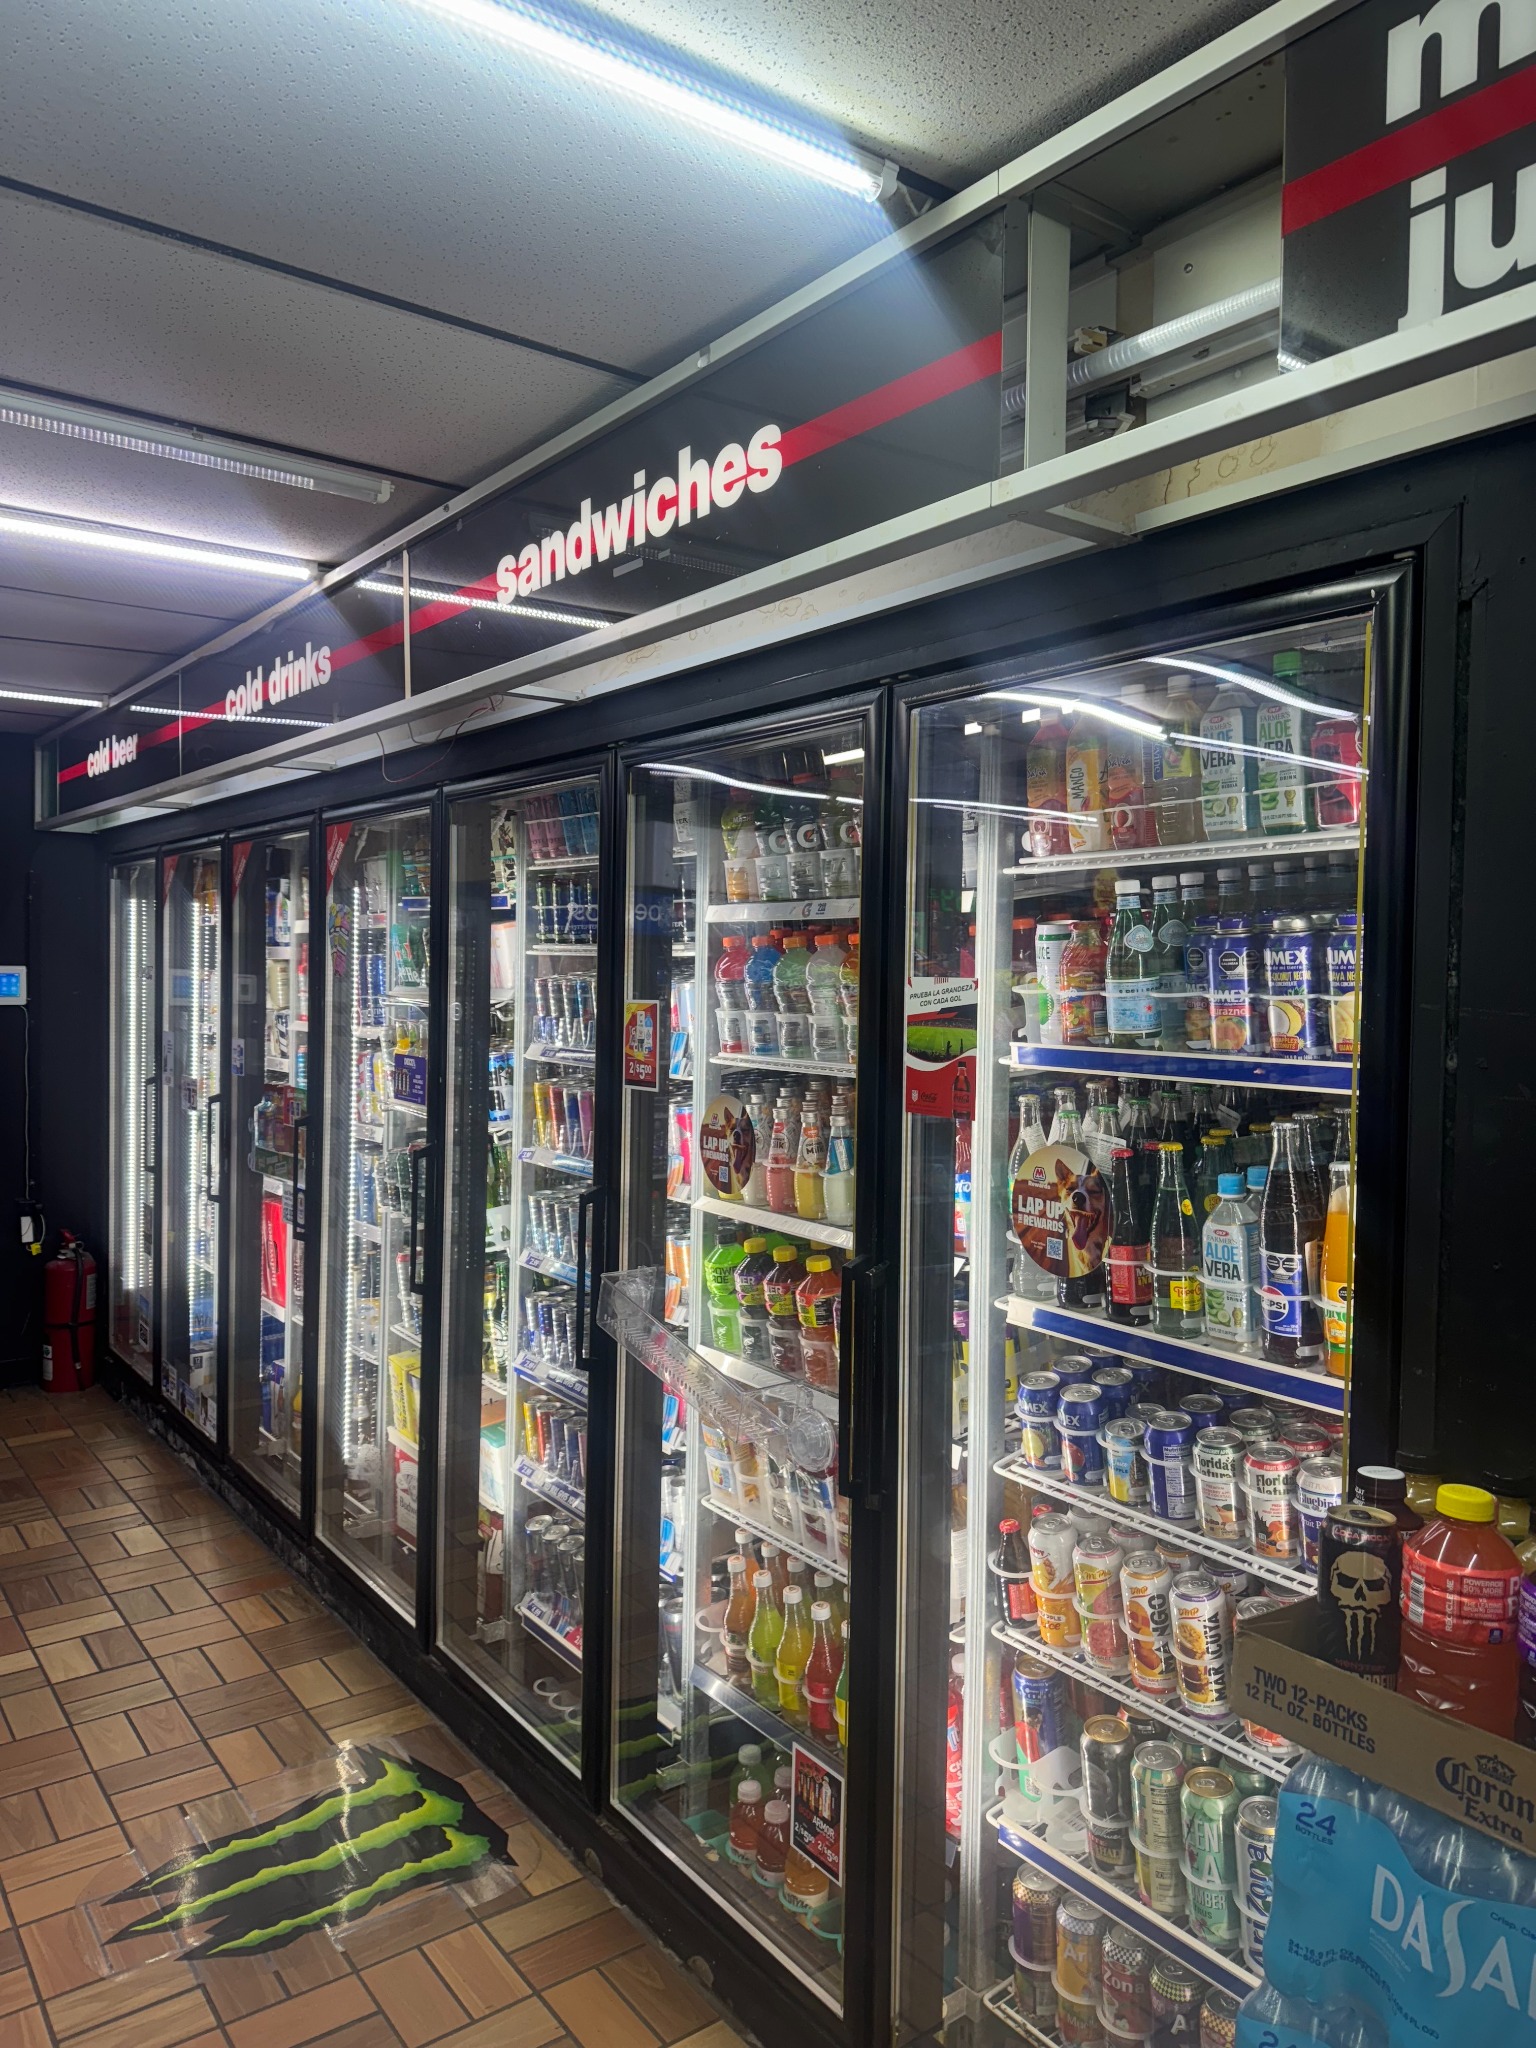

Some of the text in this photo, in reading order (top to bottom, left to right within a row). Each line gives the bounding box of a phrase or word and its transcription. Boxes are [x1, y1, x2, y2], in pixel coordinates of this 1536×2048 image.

[496, 424, 783, 605] sandwiches
[226, 642, 331, 722] cold drinks
[1260, 719, 1292, 741] ALOE
[87, 733, 138, 778] cold beer
[1202, 750, 1236, 770] VERA
[1069, 766, 1085, 800] MANGO
[796, 823, 819, 848] G
[909, 990, 932, 1000] PRUEBA
[941, 984, 973, 995] GRANDEZA
[919, 995, 962, 1007] CON CADA GOL
[703, 1135, 730, 1153] LAP UP
[1018, 1195, 1065, 1220] LAP UP
[1024, 1215, 1064, 1233] REWARDS
[1205, 1242, 1240, 1264] ALOE
[1204, 1259, 1242, 1282] VERA
[1334, 1527, 1360, 1540] LOCA
[1463, 1578, 1504, 1588] POWERADE
[1482, 1587, 1503, 1595] MORE
[1445, 1593, 1454, 1632] RECYCLE
[1254, 1665, 1368, 1732] TWO 12-PACKS
[1245, 1683, 1376, 1754] 12 FL. OZ. BOTTLES
[812, 1815, 835, 1838] ARMOR
[1296, 1801, 1336, 1837] 24
[1464, 1796, 1524, 1843] Extra
[1295, 1824, 1334, 1847] BOTTLES
